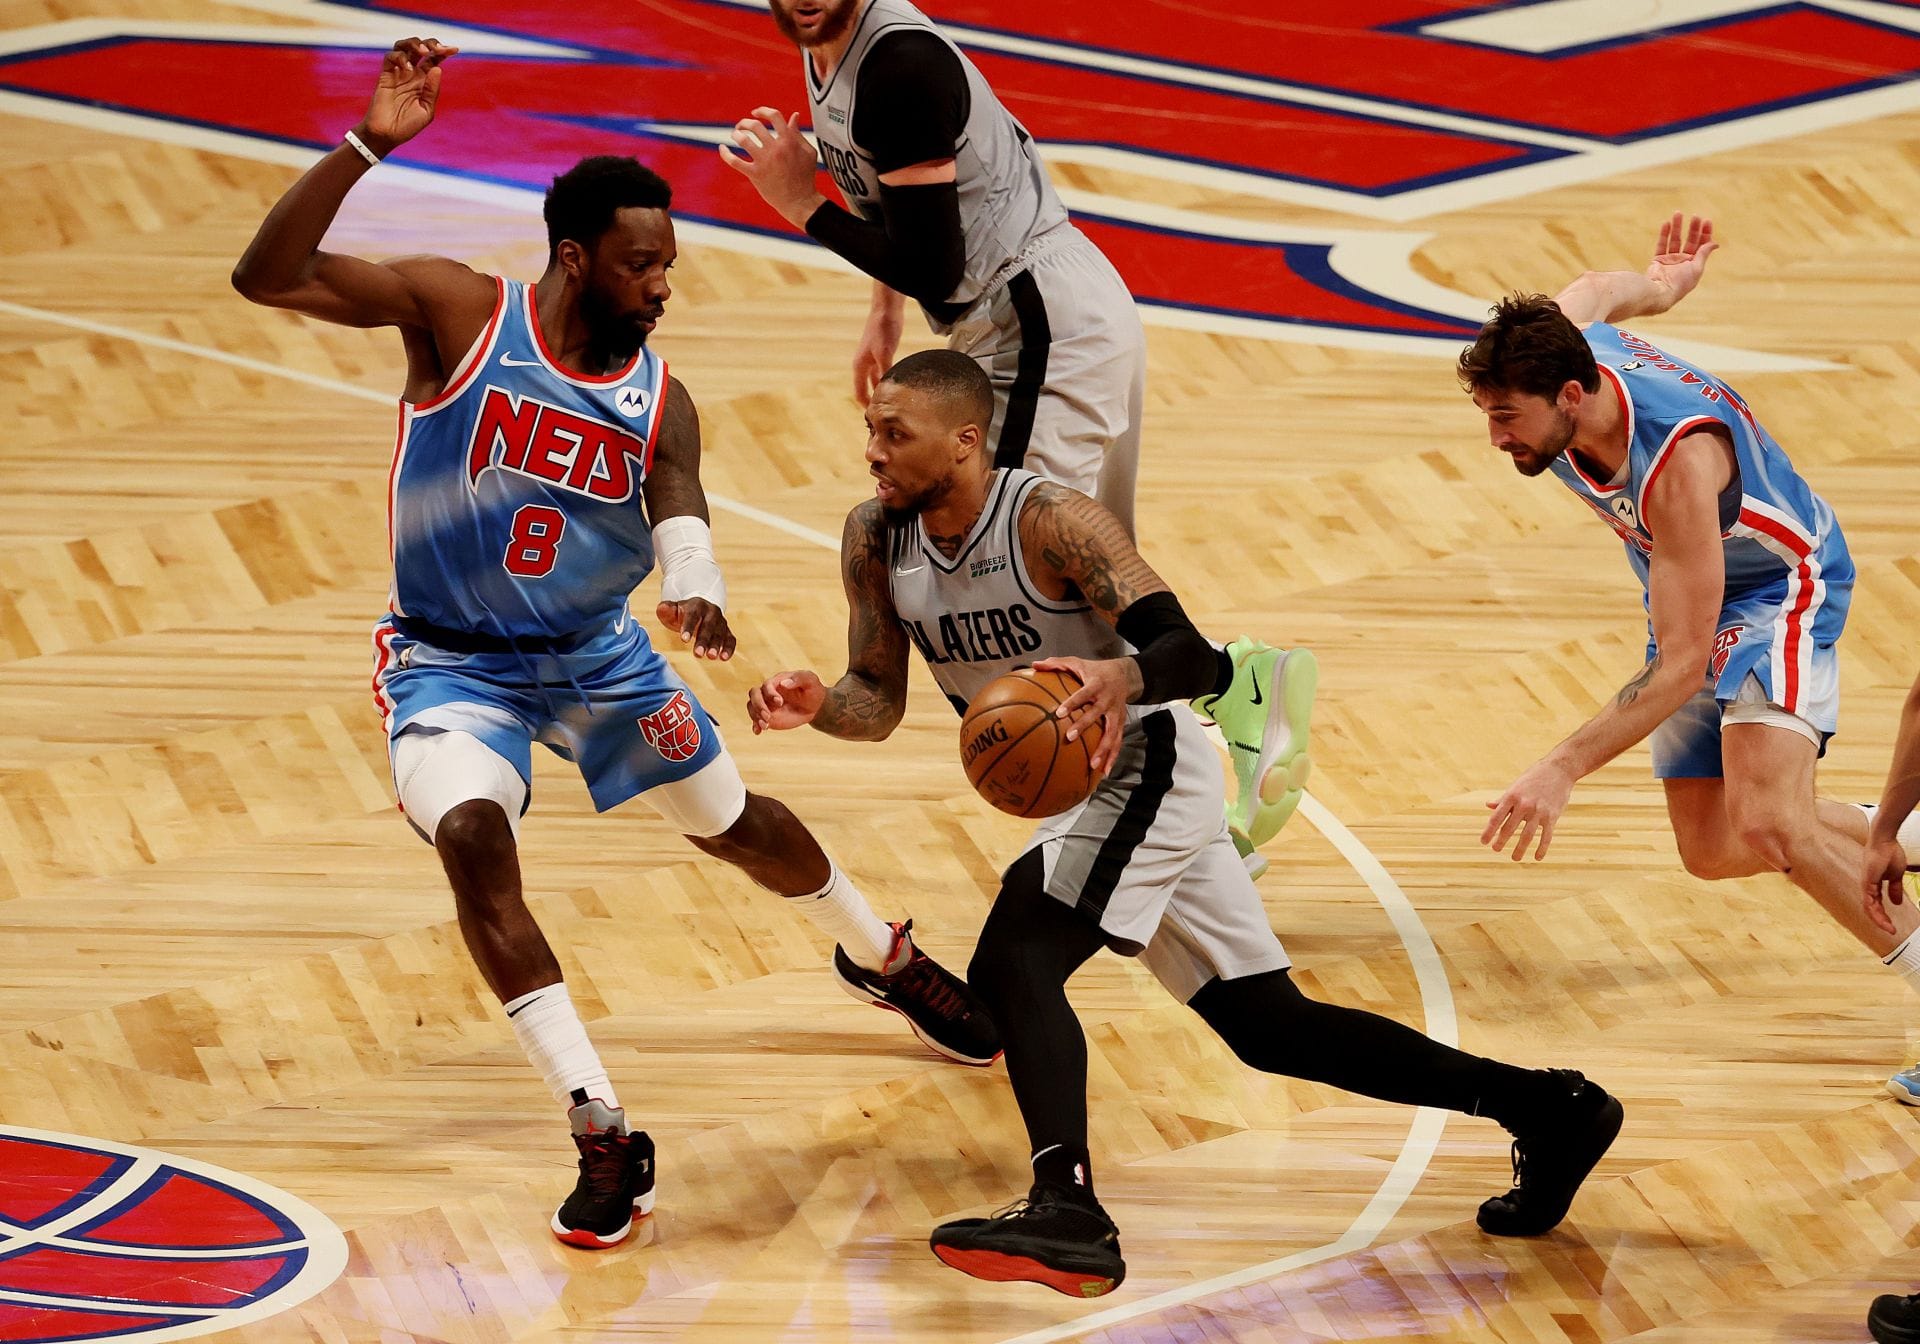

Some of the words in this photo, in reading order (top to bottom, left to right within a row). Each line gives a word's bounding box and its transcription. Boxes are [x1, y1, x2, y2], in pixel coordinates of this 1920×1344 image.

[466, 383, 648, 504] NETS
[502, 503, 567, 578] 8
[1711, 625, 1746, 657] ETS
[637, 690, 693, 748] NETS
